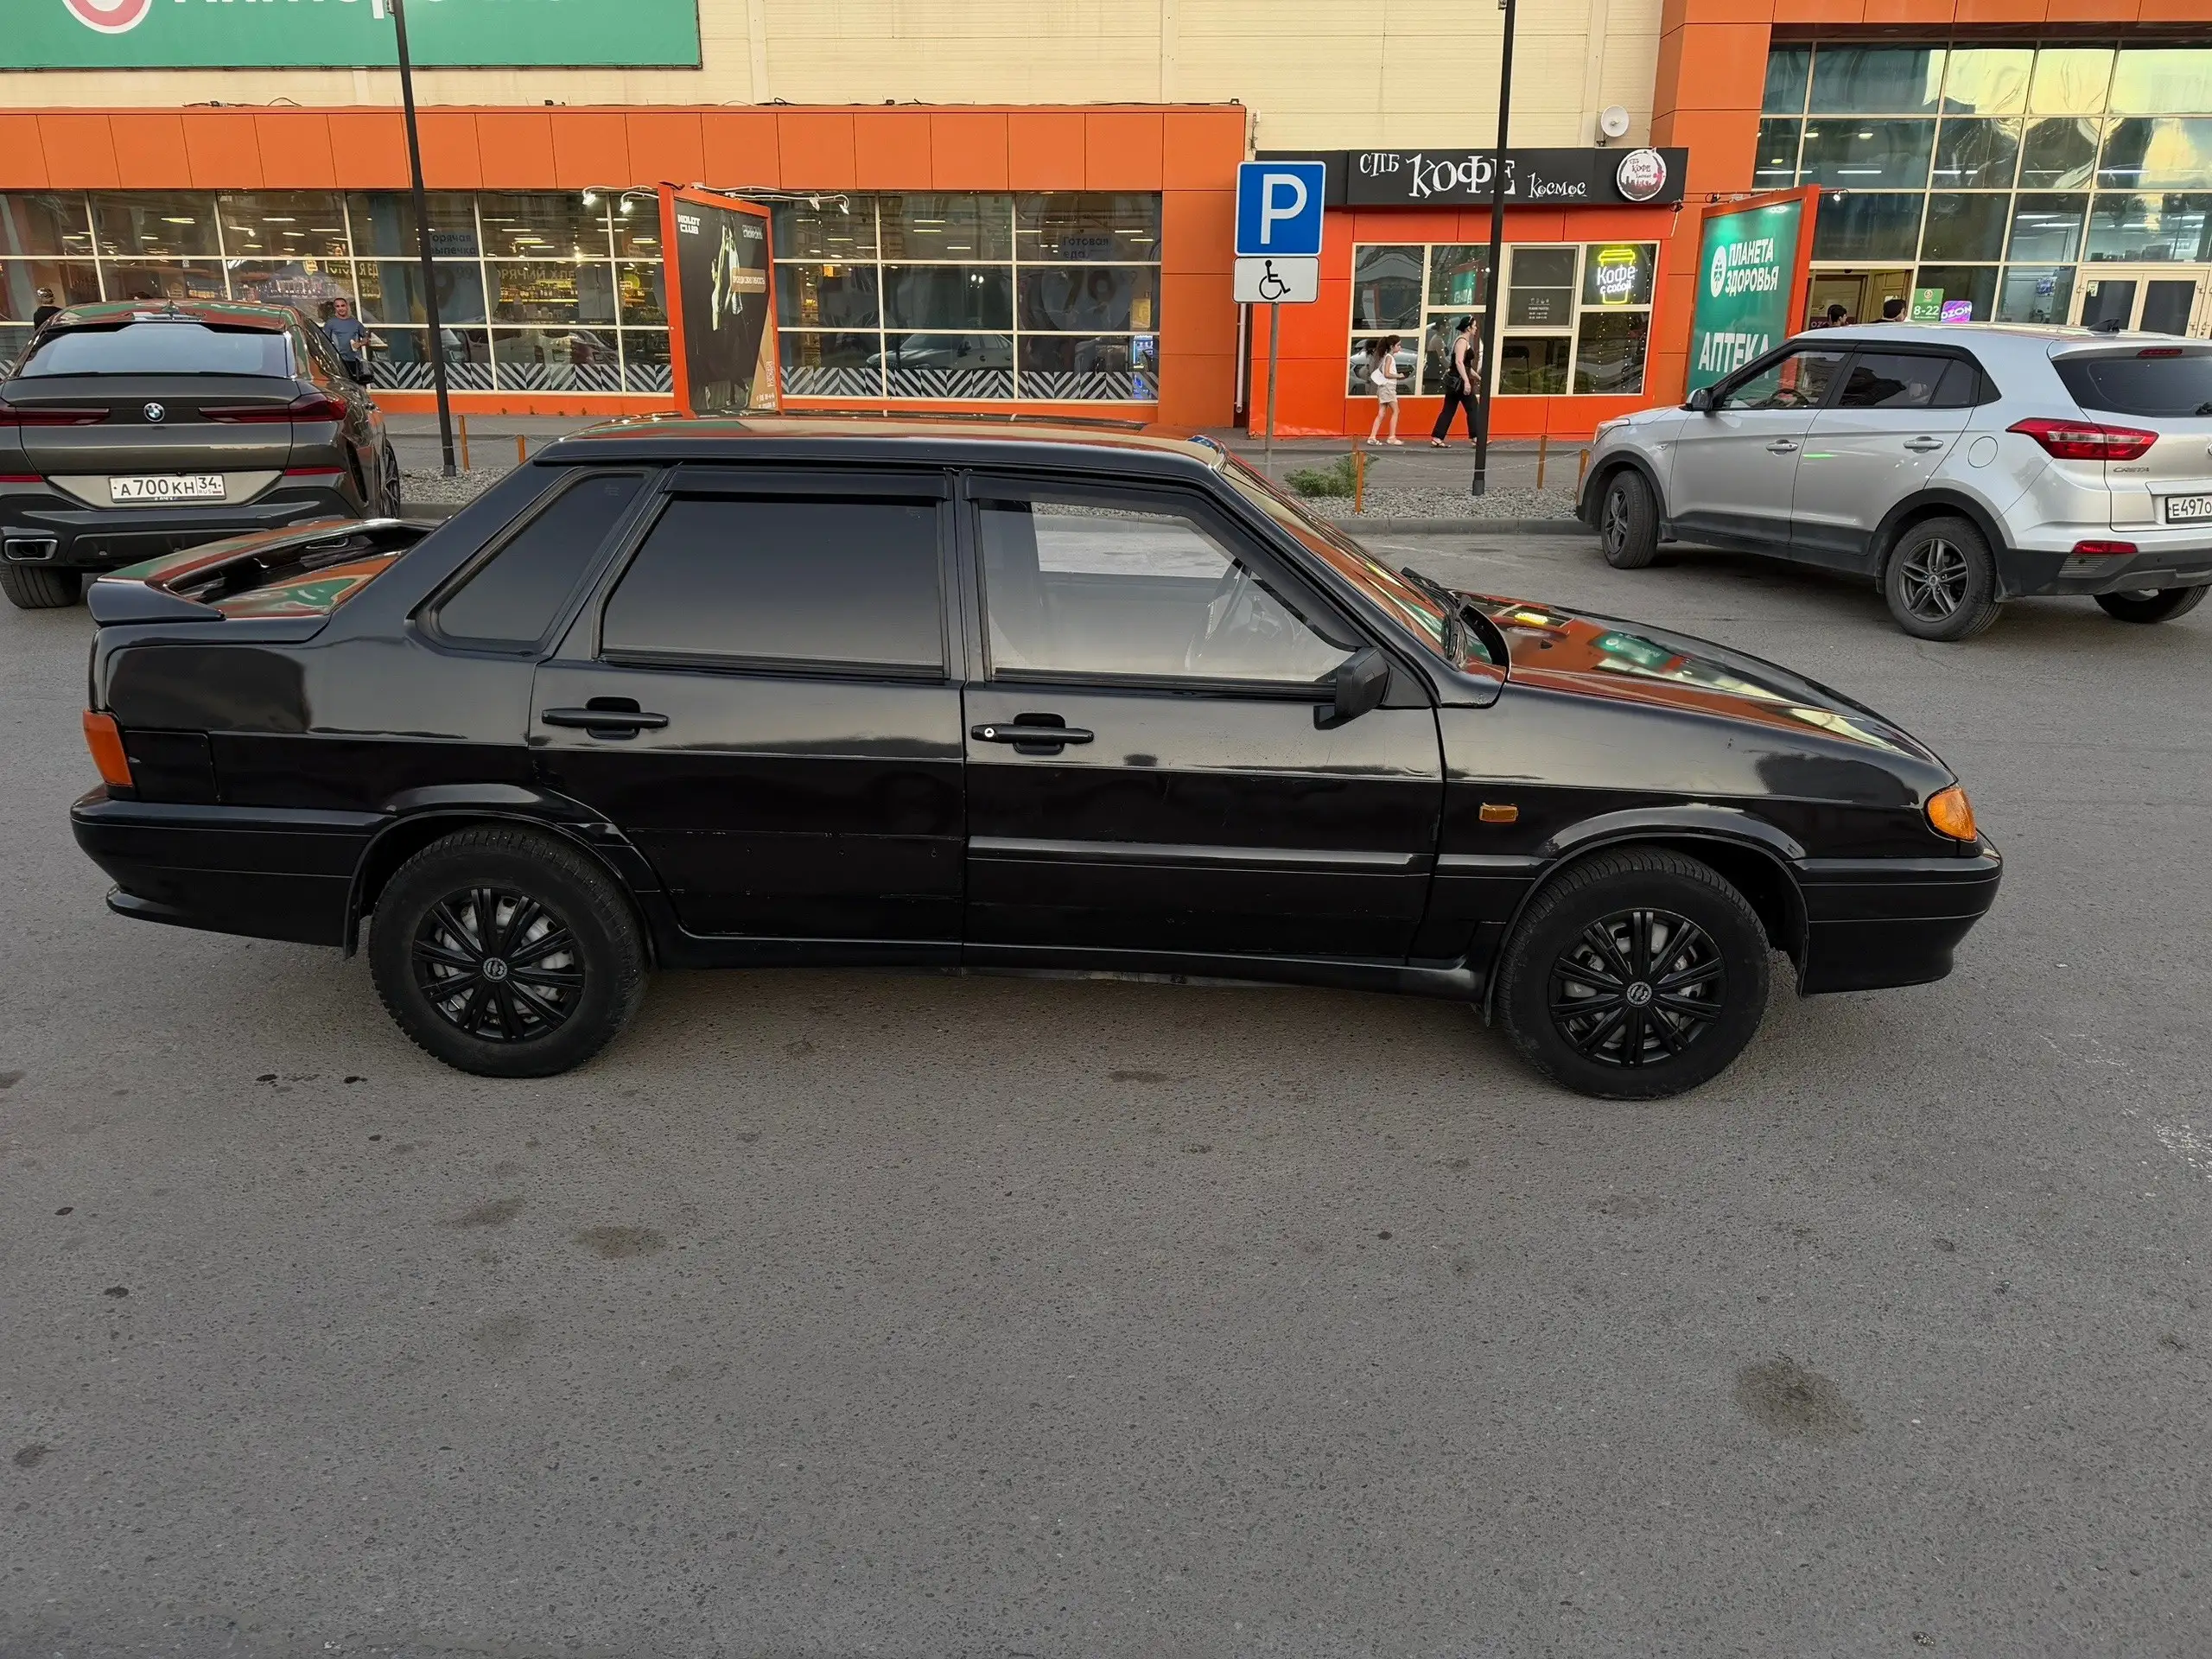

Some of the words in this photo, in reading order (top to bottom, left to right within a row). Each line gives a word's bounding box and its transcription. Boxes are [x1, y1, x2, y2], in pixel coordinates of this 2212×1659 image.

[1359, 152, 1400, 177] СПБ
[1405, 153, 1516, 200] КОФЕ
[1527, 173, 1588, 200] Космос
[1261, 174, 1307, 245] P
[679, 224, 699, 234] CLUB
[1062, 236, 1109, 246] Готовая
[1728, 238, 1774, 267] ПЛАНЕТА
[1597, 264, 1637, 285] Кофе
[1725, 266, 1780, 296] ЗДОРОВЬЯ
[1600, 285, 1606, 295] с
[1607, 279, 1632, 295] собой
[1913, 305, 1941, 315] 8-22
[1941, 304, 1972, 320] OZON
[1698, 332, 1770, 378] АПТЕКА
[198, 476, 217, 489] 34
